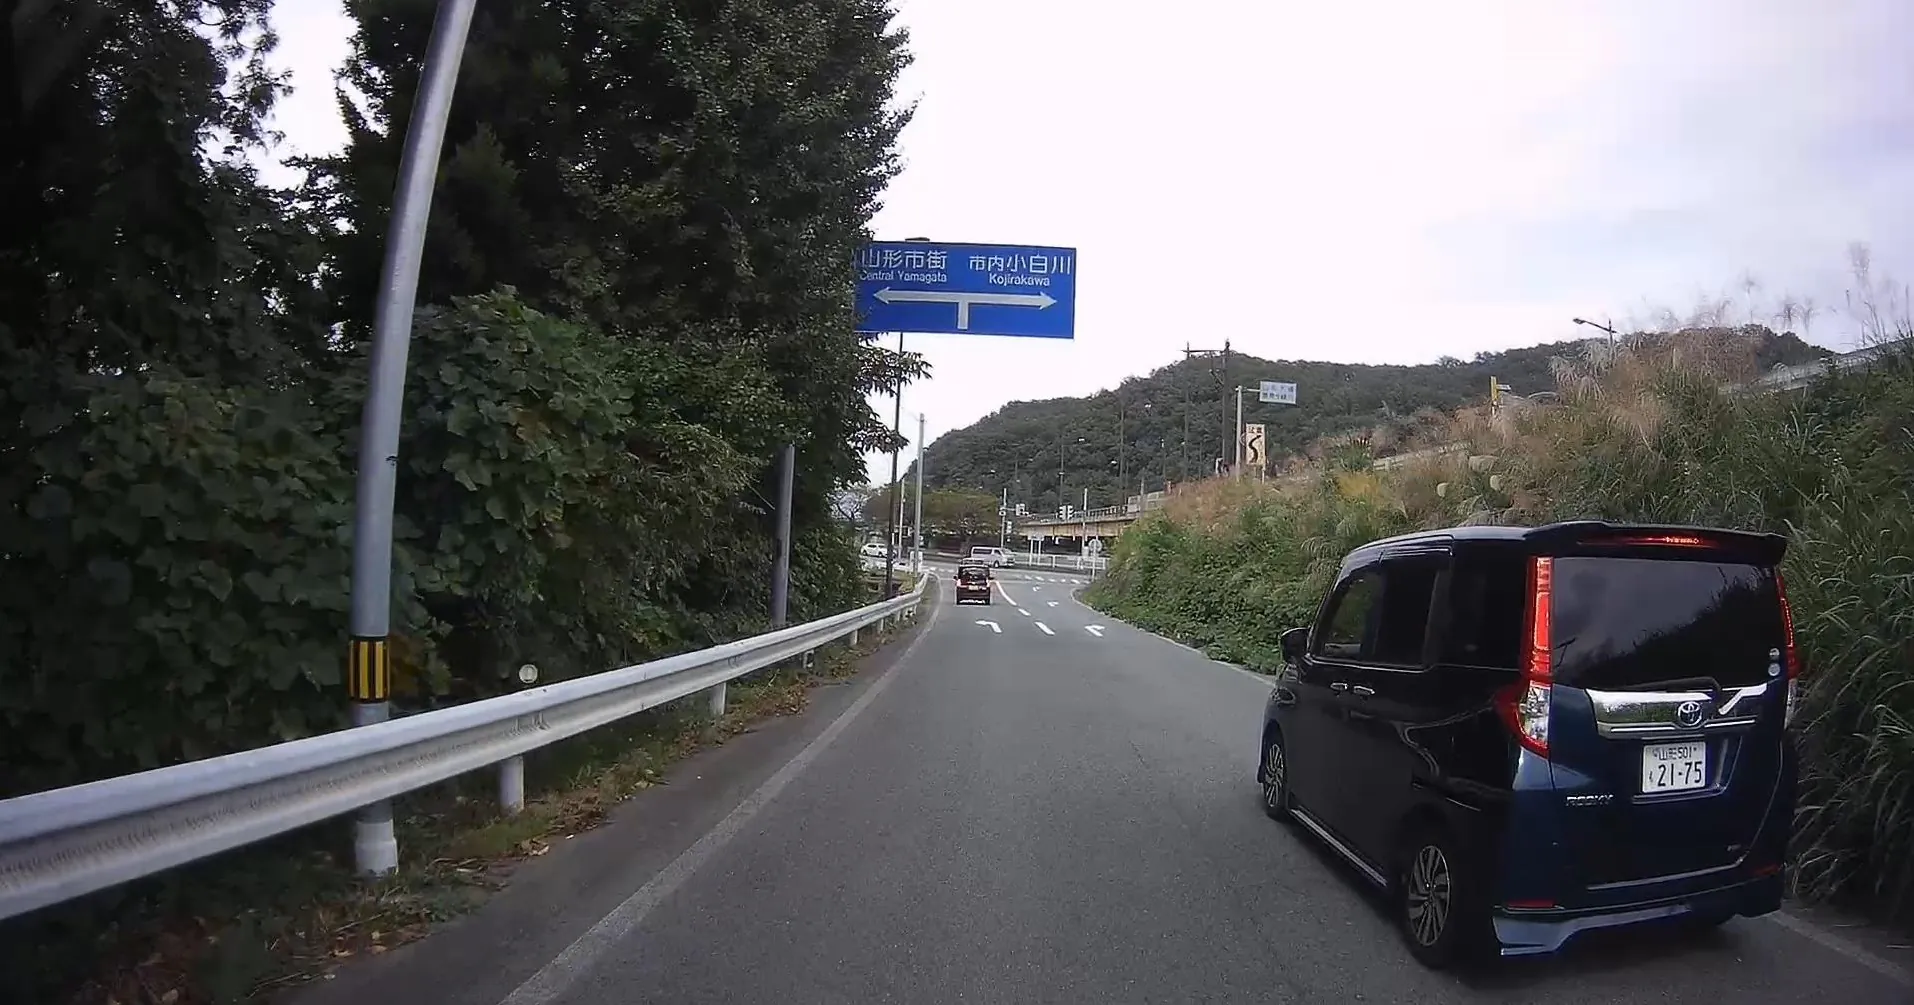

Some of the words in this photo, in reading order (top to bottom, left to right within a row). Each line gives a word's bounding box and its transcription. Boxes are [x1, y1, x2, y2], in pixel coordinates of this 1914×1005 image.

[861, 247, 948, 270] 山形市街
[968, 250, 1072, 275] 市内小白川
[860, 269, 894, 281] Central
[897, 270, 948, 284] Yamagata
[988, 272, 1051, 287] Kojirakawa
